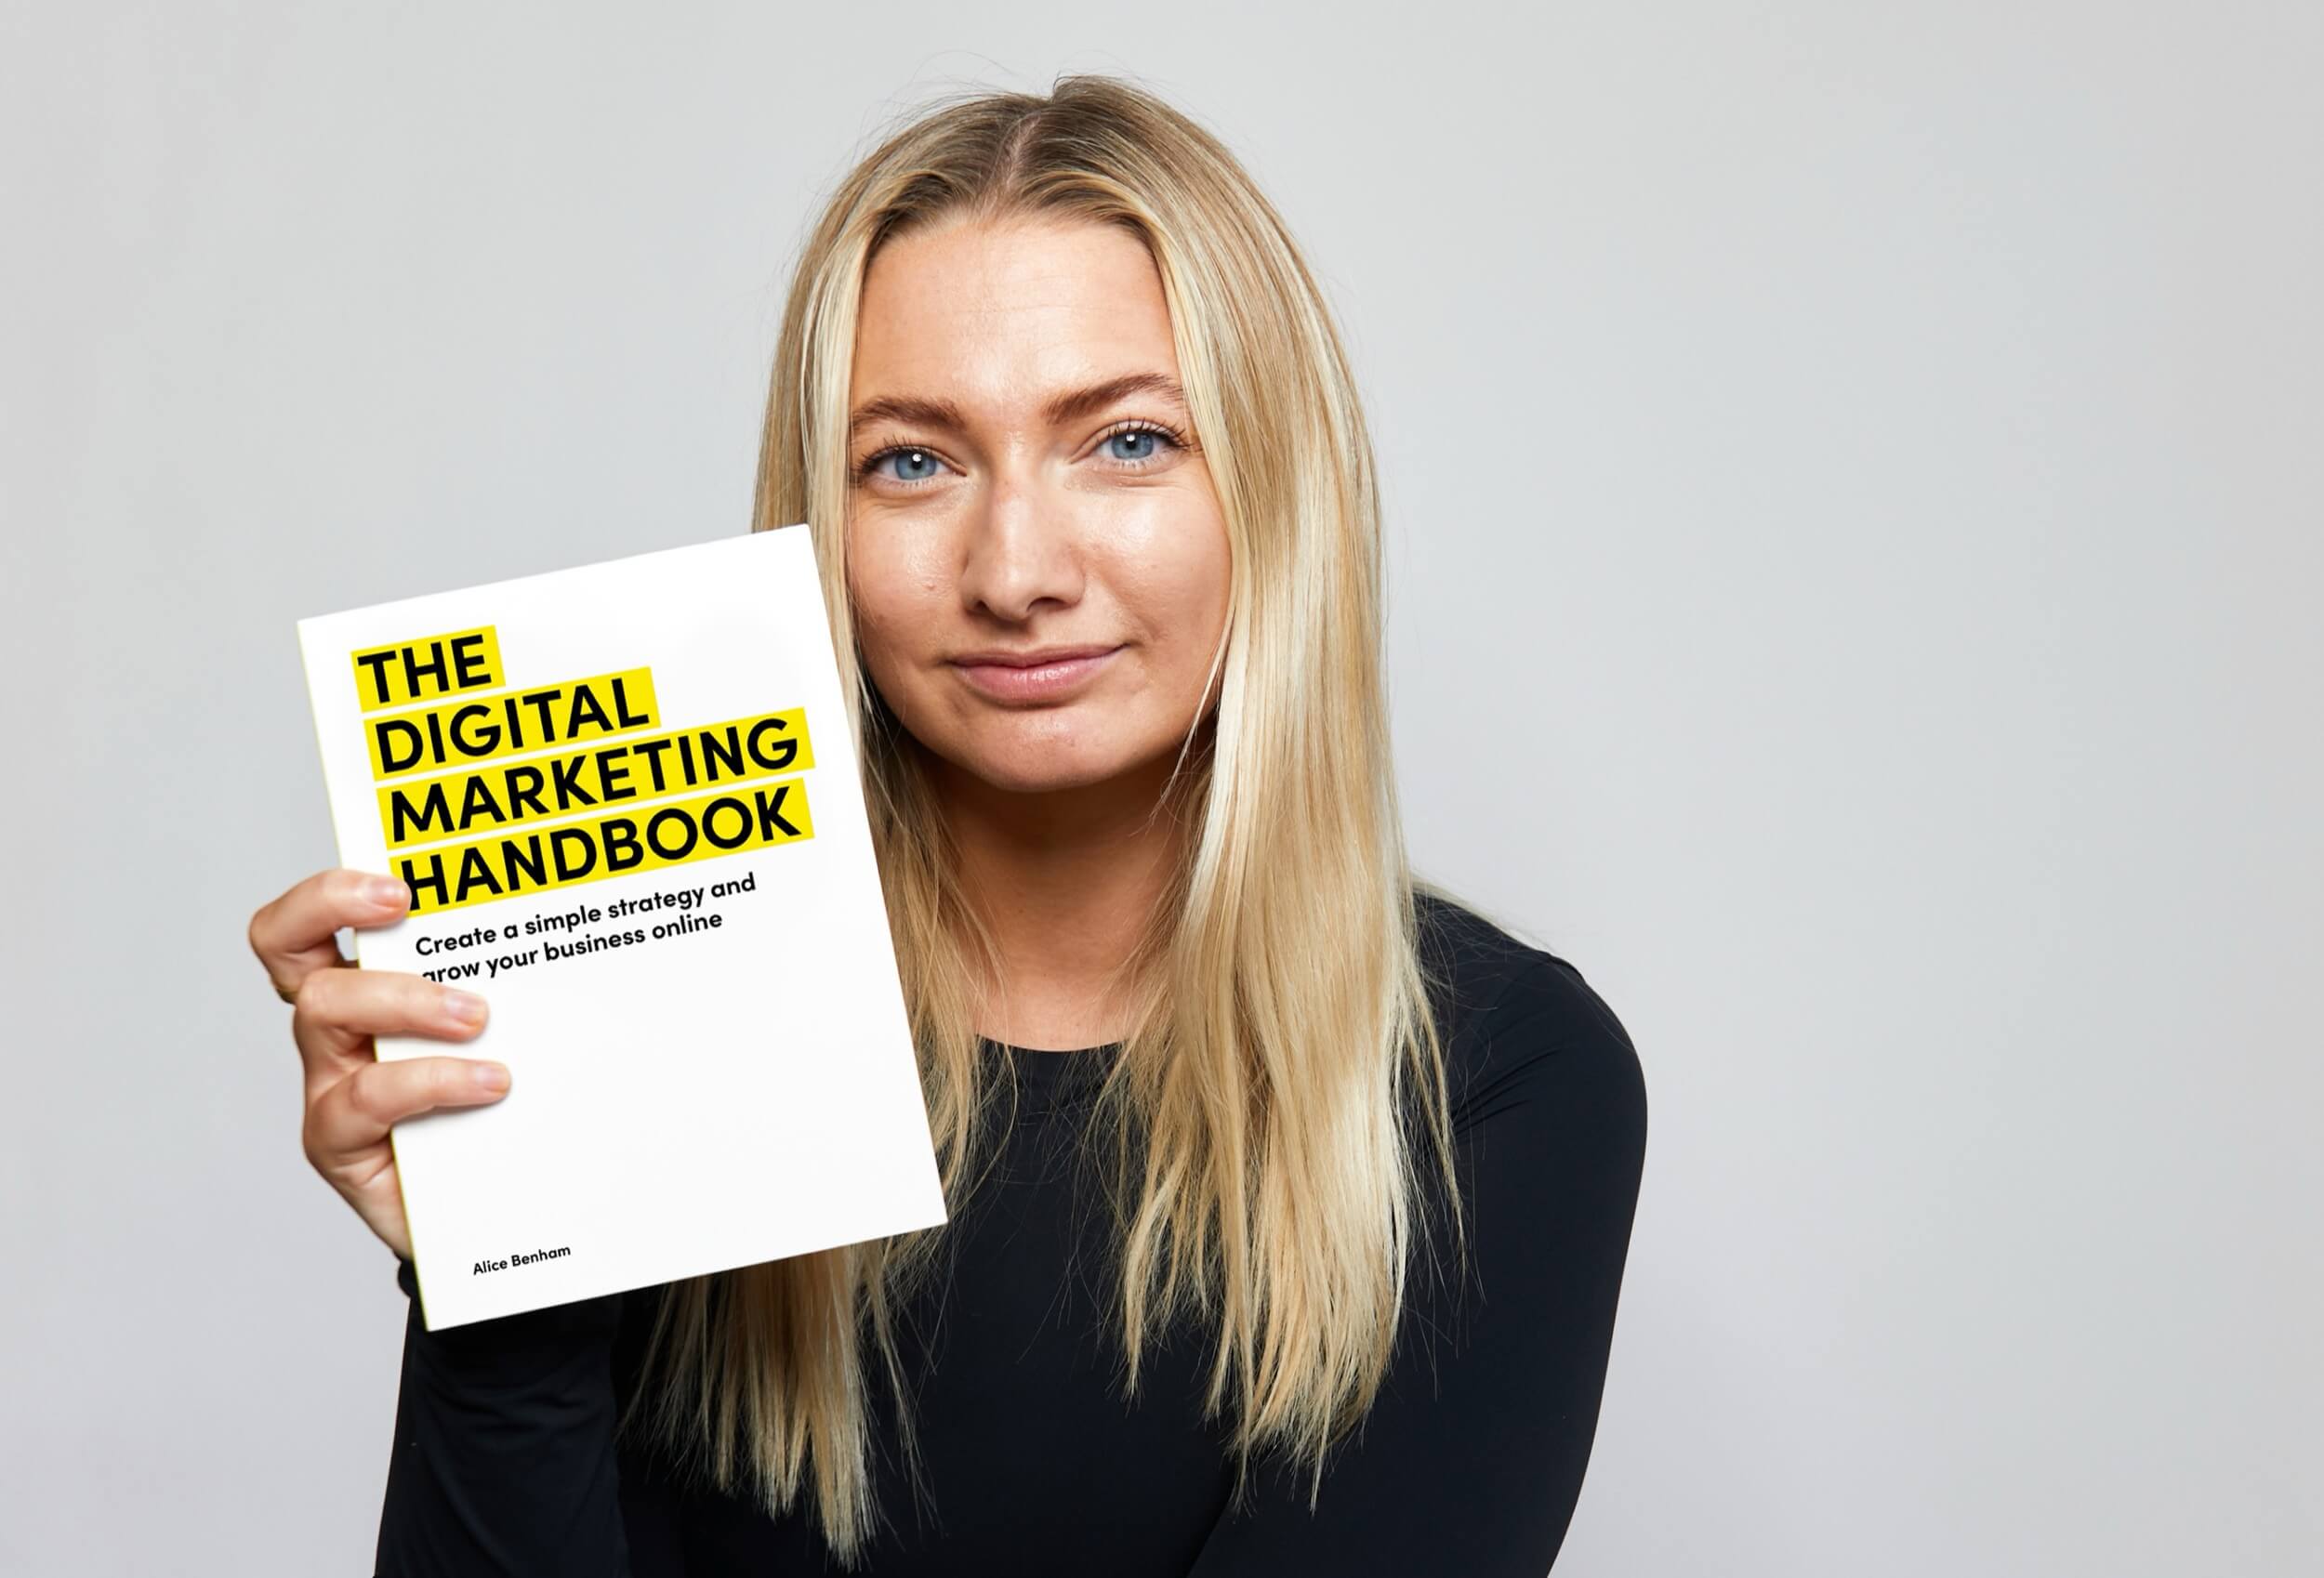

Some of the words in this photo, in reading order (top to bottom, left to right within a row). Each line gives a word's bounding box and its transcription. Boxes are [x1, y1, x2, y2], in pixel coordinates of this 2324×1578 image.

[358, 635, 491, 704] THE
[376, 678, 650, 774] DIGITAL
[391, 718, 798, 843] MARKETING
[401, 787, 801, 912] HANDBOOK
[416, 927, 496, 956] Create
[503, 925, 519, 940] a
[524, 904, 601, 935] simple
[608, 888, 705, 919] strategy
[710, 871, 756, 898] and
[485, 950, 538, 979] your
[543, 929, 646, 962] business
[652, 914, 722, 940] online
[473, 1260, 508, 1275] Alice
[510, 1246, 571, 1267] Benham
